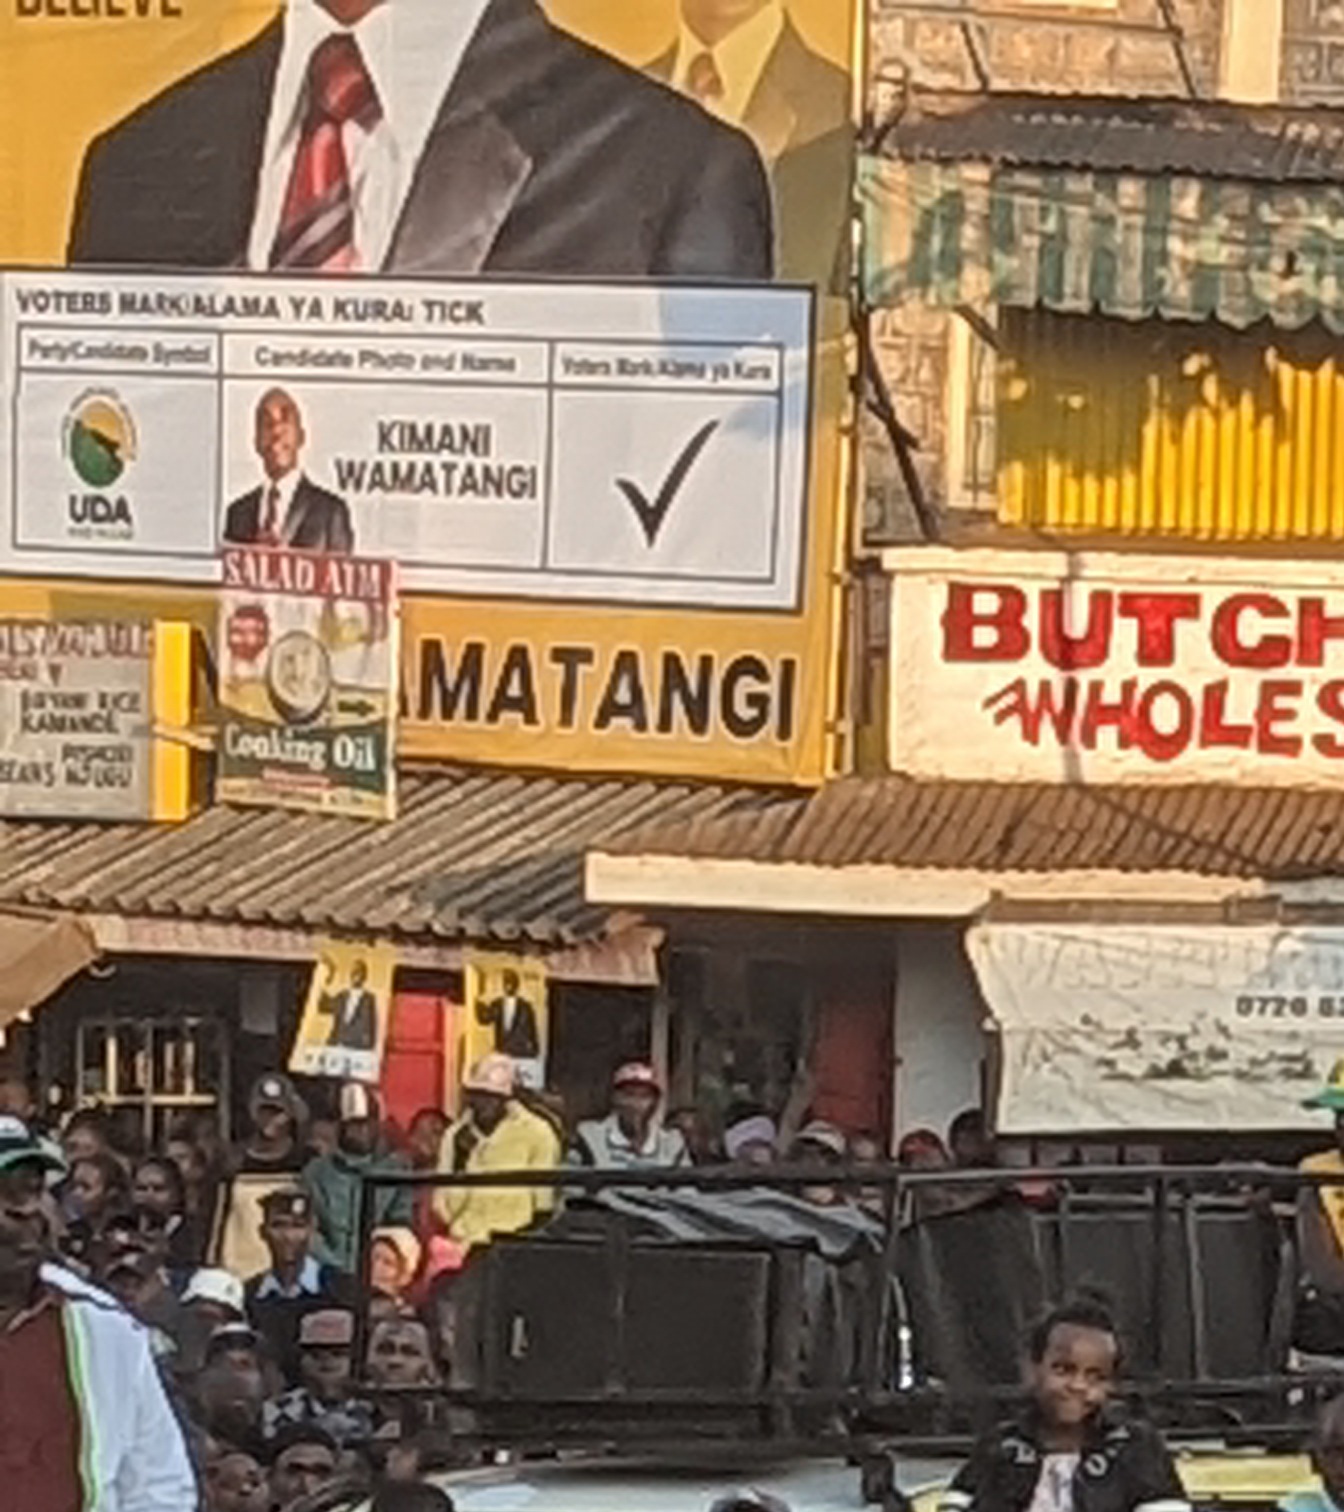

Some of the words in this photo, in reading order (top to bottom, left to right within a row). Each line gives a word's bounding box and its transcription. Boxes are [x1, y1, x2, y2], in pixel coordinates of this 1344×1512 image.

[16, 289, 112, 315] VOTERS
[288, 299, 323, 320] YA
[424, 300, 485, 324] TICK
[254, 345, 355, 370] Candidate
[358, 349, 415, 372] Photo
[420, 353, 456, 373] and
[461, 353, 517, 374] Name
[375, 420, 492, 457] KIMANI
[334, 459, 537, 501] WAMATANGI
[69, 493, 133, 527] UDA
[224, 552, 316, 592] SALAD
[401, 638, 797, 742] MATANGI
[224, 722, 327, 771] Cooking
[332, 733, 377, 771] Oil
